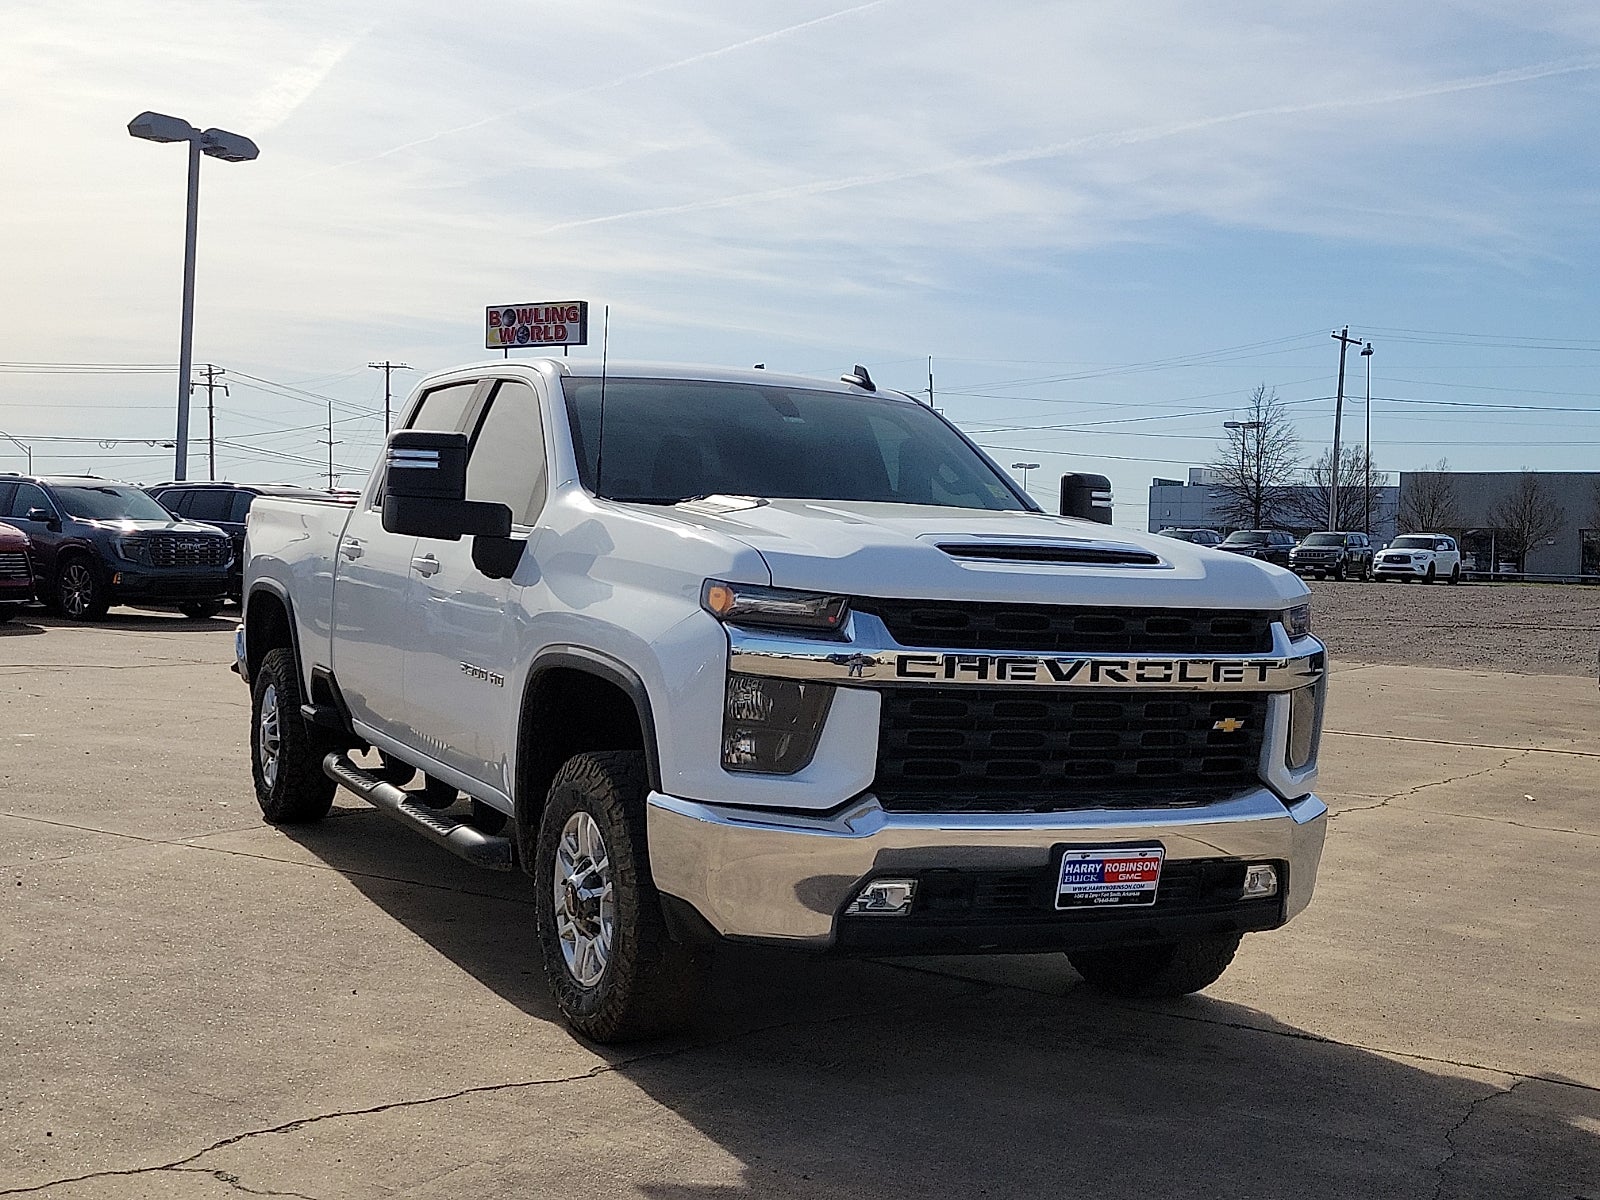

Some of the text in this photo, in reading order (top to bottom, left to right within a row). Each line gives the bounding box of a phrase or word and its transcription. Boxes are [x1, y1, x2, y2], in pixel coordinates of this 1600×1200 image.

[489, 306, 580, 328] BOWLING
[499, 325, 568, 344] WORLD
[895, 654, 1280, 683] CHEVROLET
[1065, 861, 1159, 874] HARRY ROBINSON
[1063, 873, 1142, 883] BUICK GMC
